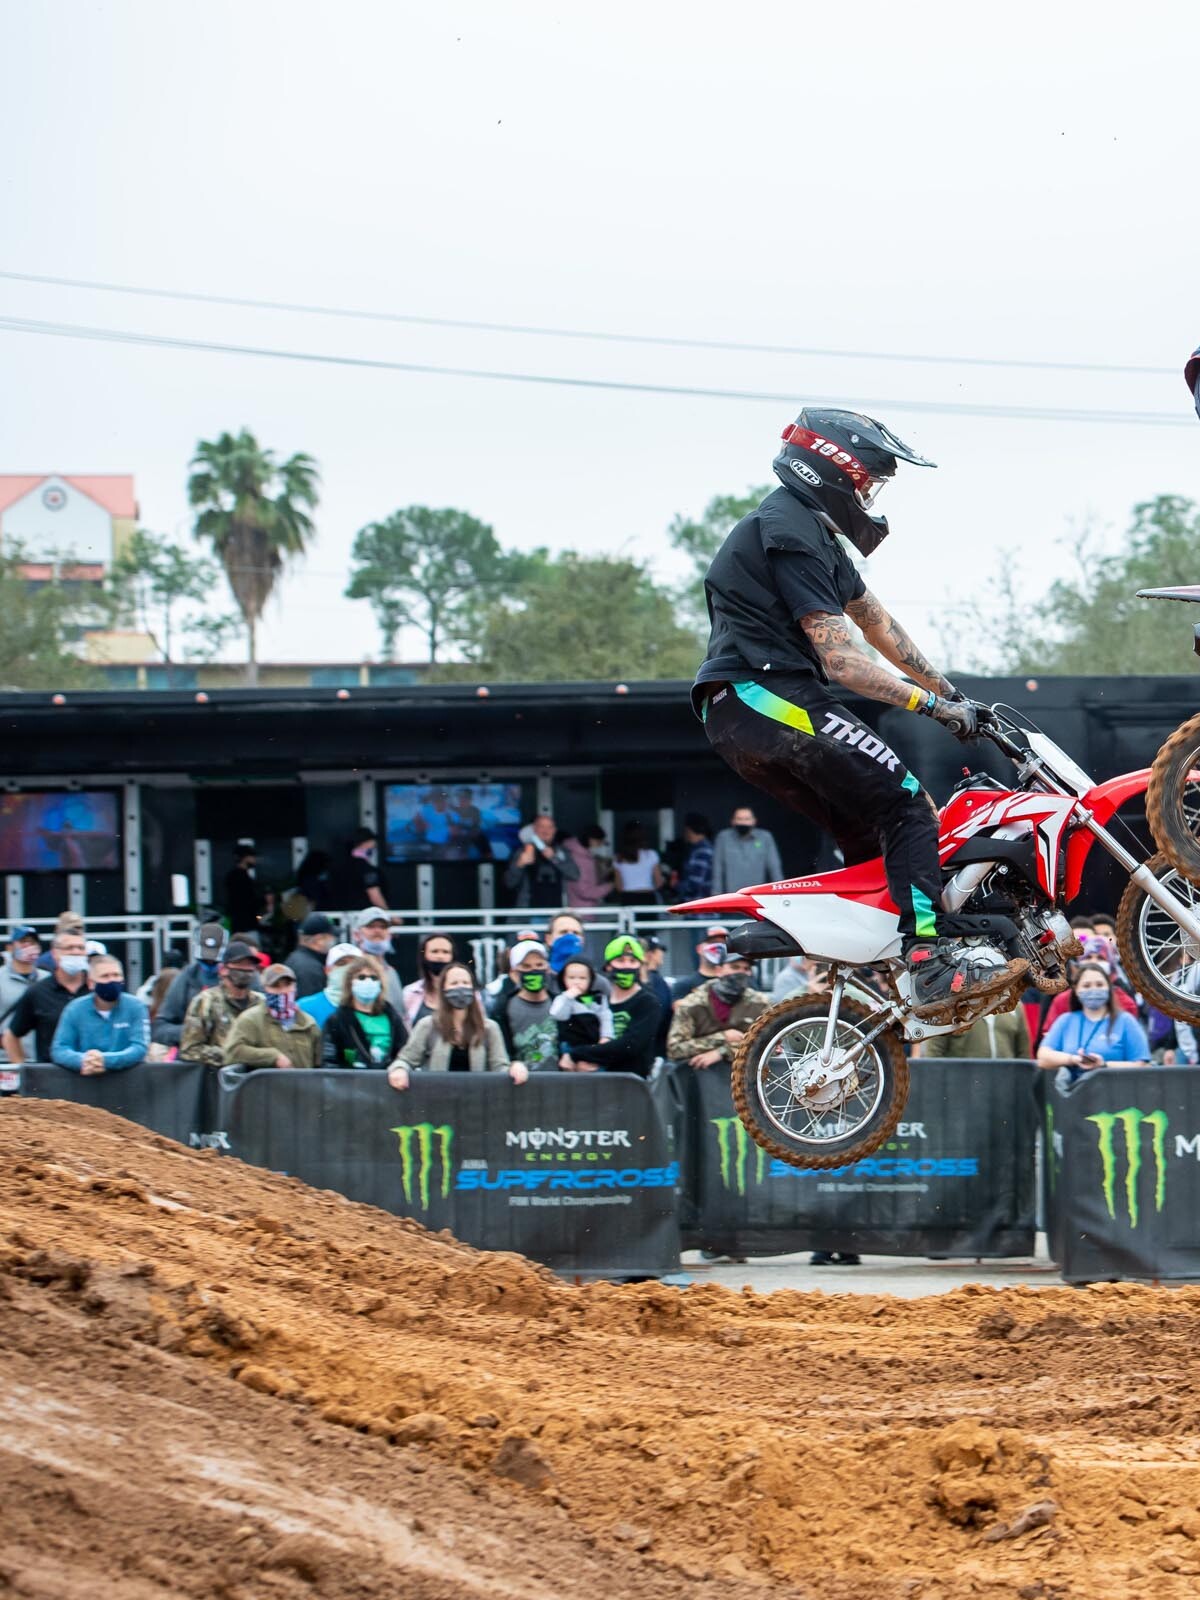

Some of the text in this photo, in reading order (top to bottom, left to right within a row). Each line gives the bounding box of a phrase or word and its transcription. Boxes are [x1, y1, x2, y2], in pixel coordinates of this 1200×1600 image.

[793, 462, 818, 484] HJC
[820, 712, 900, 772] THOR
[772, 881, 822, 890] HONDA
[505, 1128, 632, 1150] MONSTER
[525, 1152, 613, 1162] ENERGY
